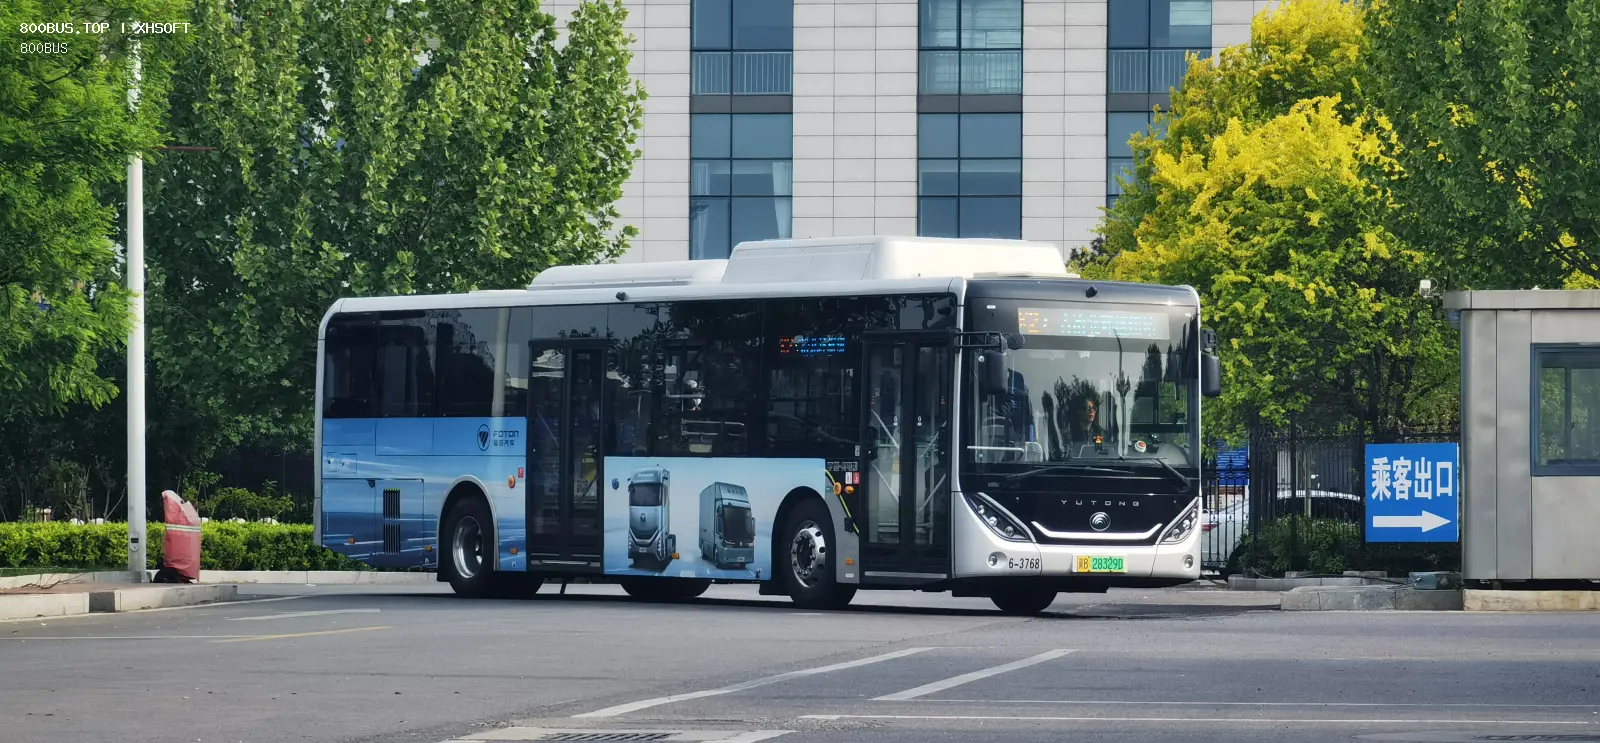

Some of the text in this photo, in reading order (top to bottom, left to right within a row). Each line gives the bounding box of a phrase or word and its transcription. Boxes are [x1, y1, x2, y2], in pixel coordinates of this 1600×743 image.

[492, 430, 519, 438] FOTON
[1371, 456, 1453, 501] 乘客出口
[1008, 557, 1040, 570] 6-3768
[1092, 557, 1124, 570] 28329D
